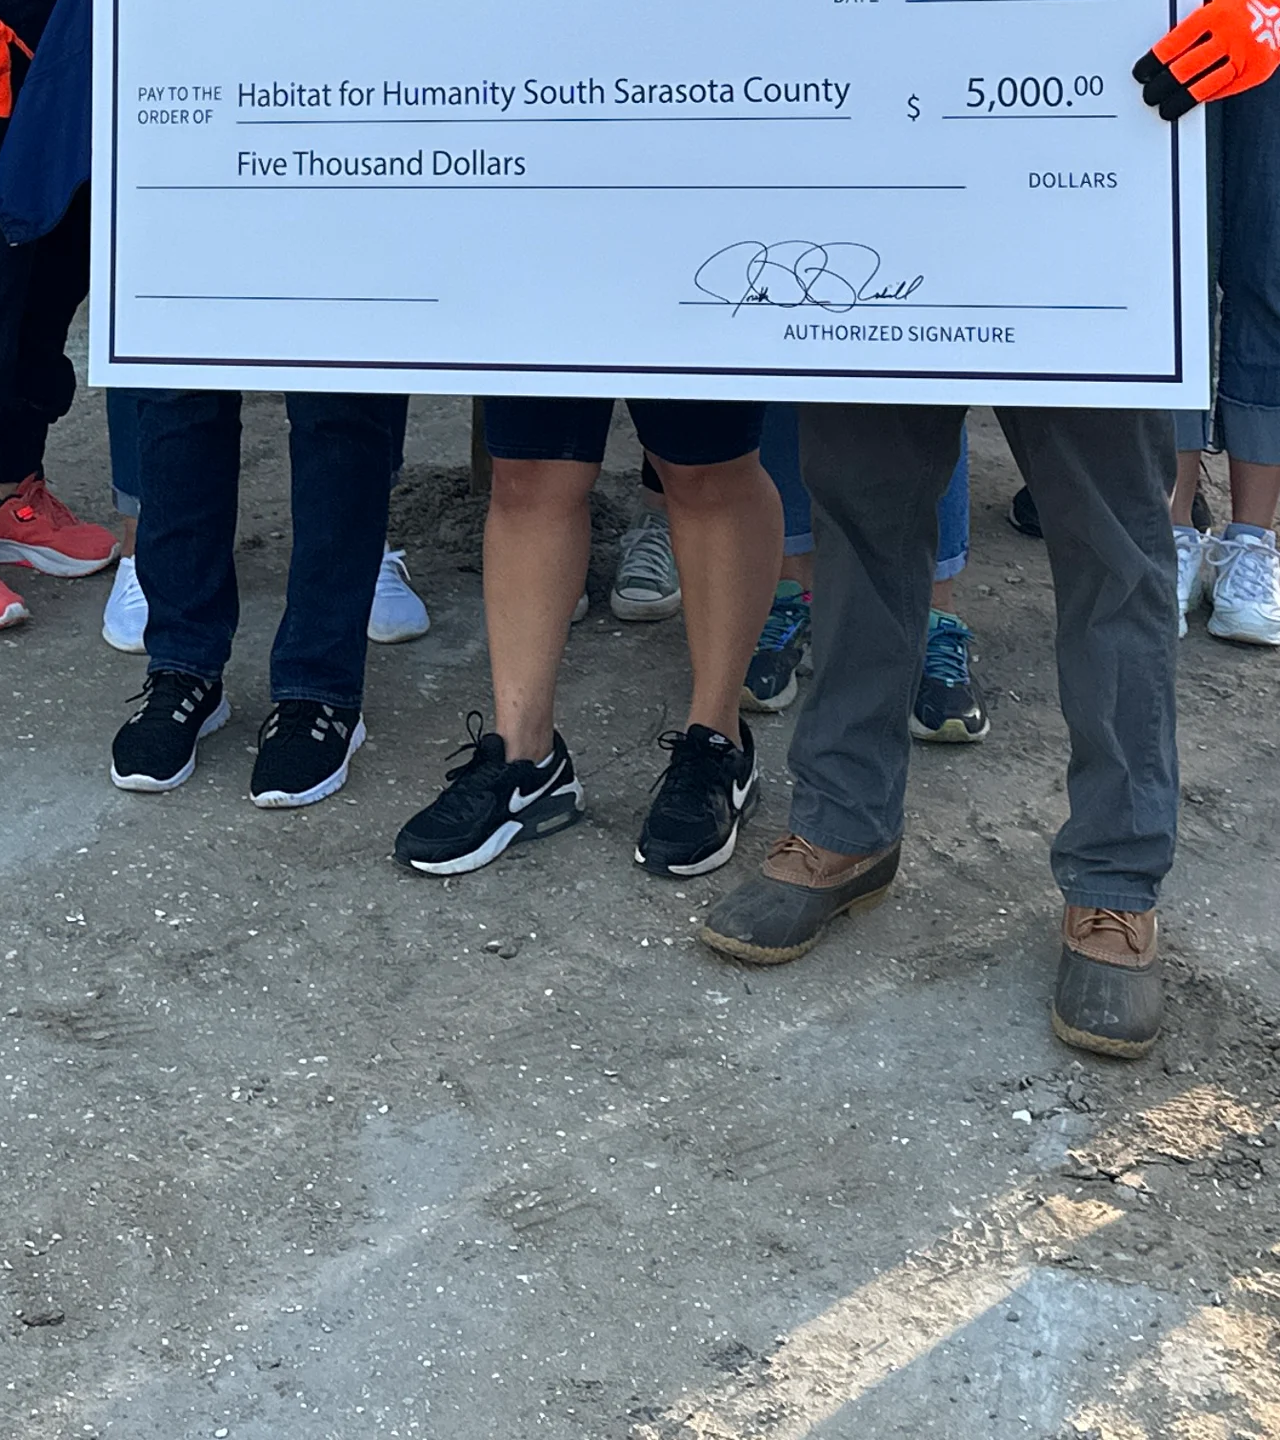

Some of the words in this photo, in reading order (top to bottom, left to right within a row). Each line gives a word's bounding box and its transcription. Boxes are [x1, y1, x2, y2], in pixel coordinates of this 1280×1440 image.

[138, 86, 166, 103] PAY
[168, 86, 189, 102] TO
[192, 85, 222, 102] THE
[237, 81, 332, 108] Habitat
[338, 79, 375, 107] for
[383, 79, 516, 113] Humanity
[523, 77, 605, 106] South
[613, 77, 734, 106] Sarasota
[744, 76, 851, 109] County
[137, 109, 189, 125] ORDER
[193, 109, 214, 125] OF
[906, 93, 921, 122] $
[237, 152, 287, 177] Five
[293, 150, 423, 177] Thousand
[432, 150, 526, 176] Dollars
[1028, 171, 1118, 190] DOLLARS
[783, 324, 903, 343] AUTHORIZED
[908, 325, 1016, 344] SIGNATURE
